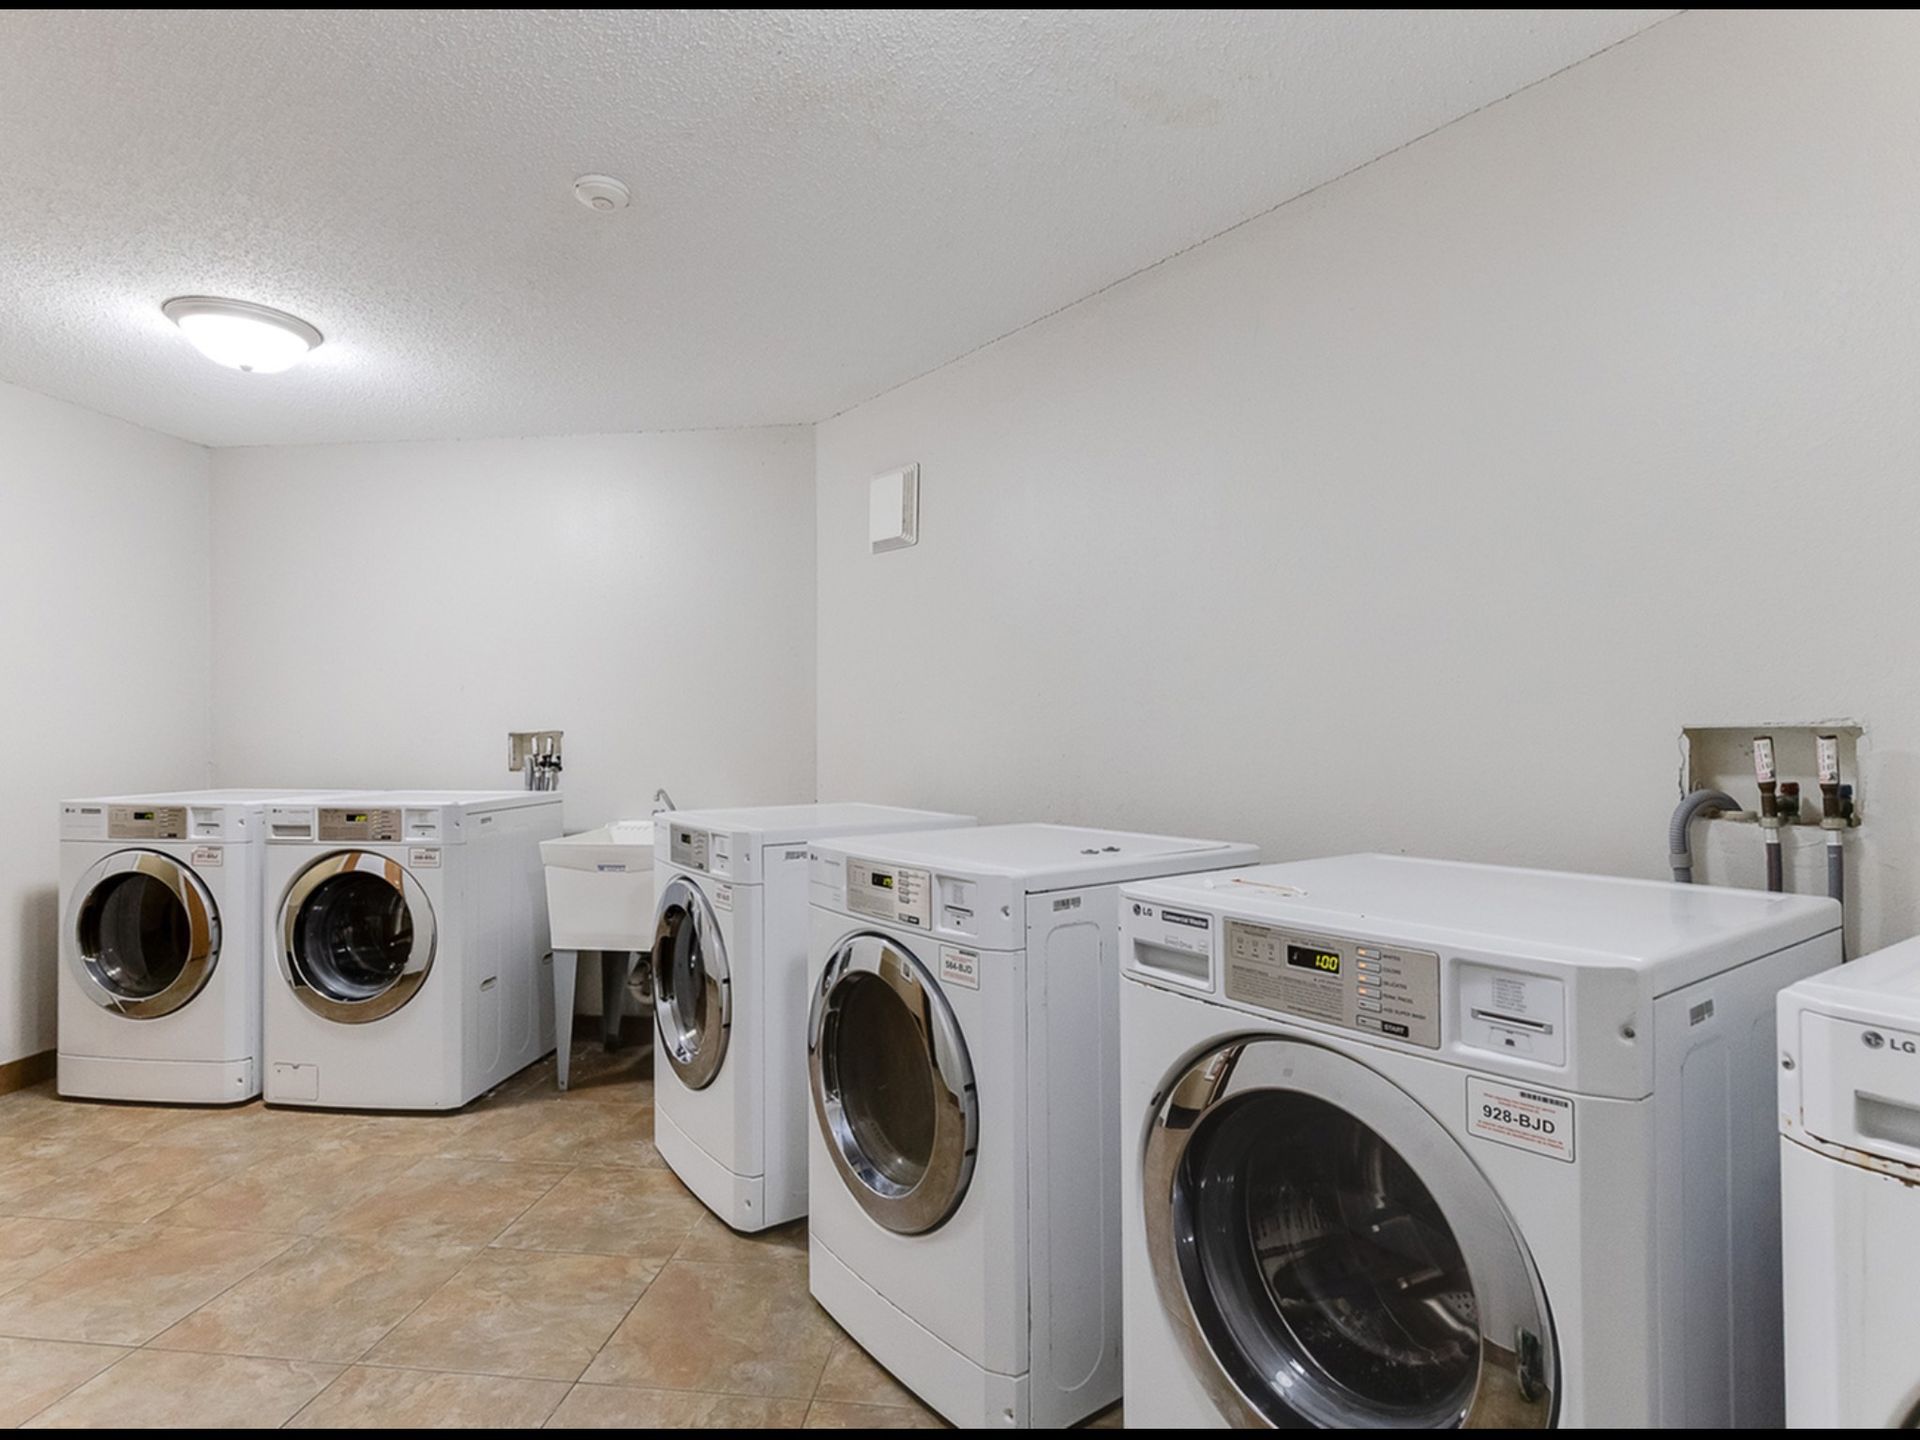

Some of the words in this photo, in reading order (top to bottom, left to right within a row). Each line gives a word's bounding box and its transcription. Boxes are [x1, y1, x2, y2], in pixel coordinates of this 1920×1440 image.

[1142, 906, 1153, 917] LG
[1383, 1023, 1406, 1035] START
[1890, 1038, 1916, 1054] LG
[1482, 1104, 1556, 1134] 928-BJD
